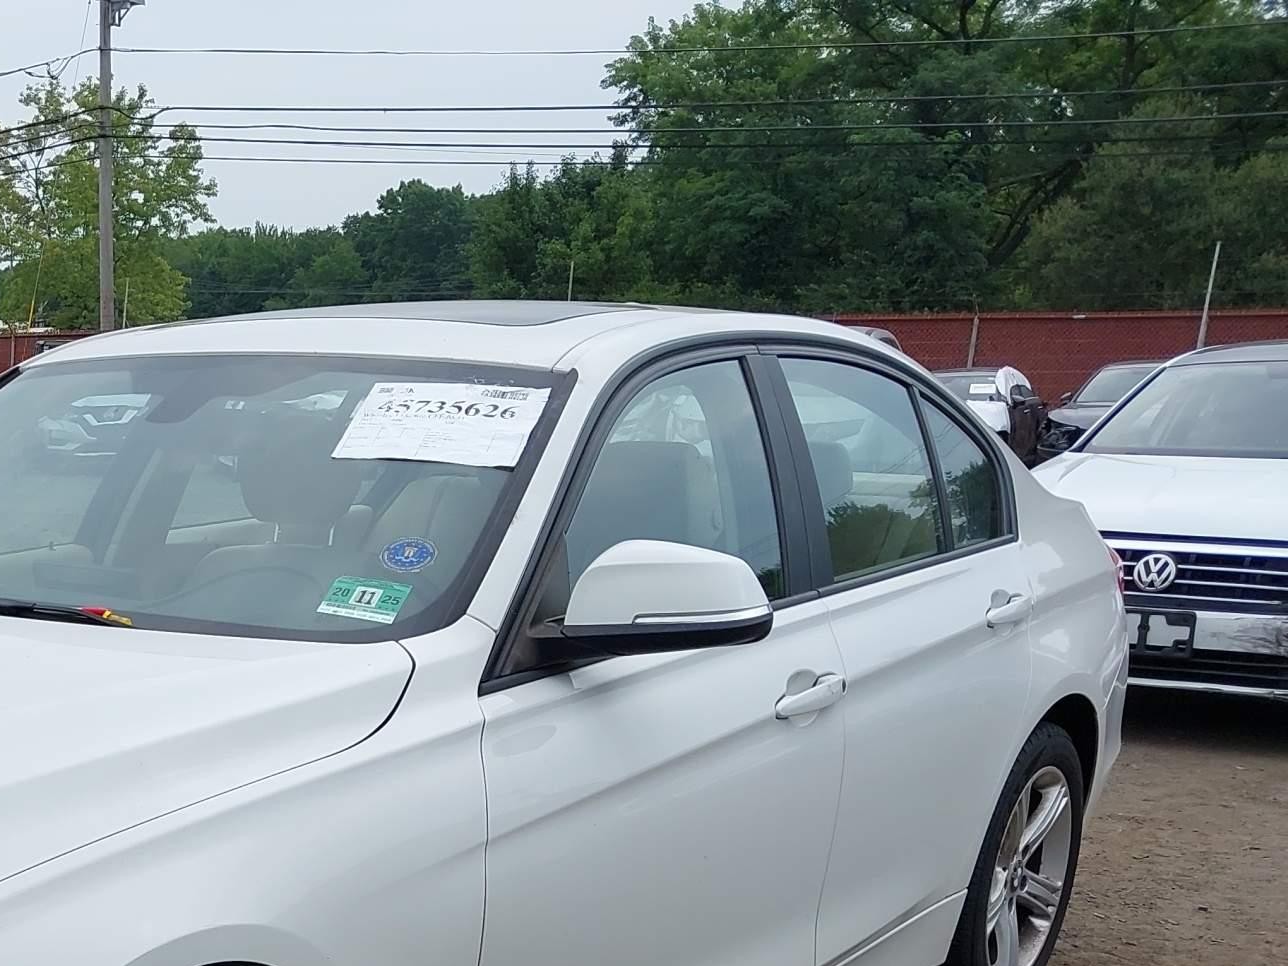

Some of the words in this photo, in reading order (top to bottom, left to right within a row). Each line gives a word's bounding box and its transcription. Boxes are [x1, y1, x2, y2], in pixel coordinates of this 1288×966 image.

[377, 399, 521, 420] 45735626
[332, 587, 351, 598] 20
[355, 589, 377, 606] 11
[381, 594, 400, 606] 25
